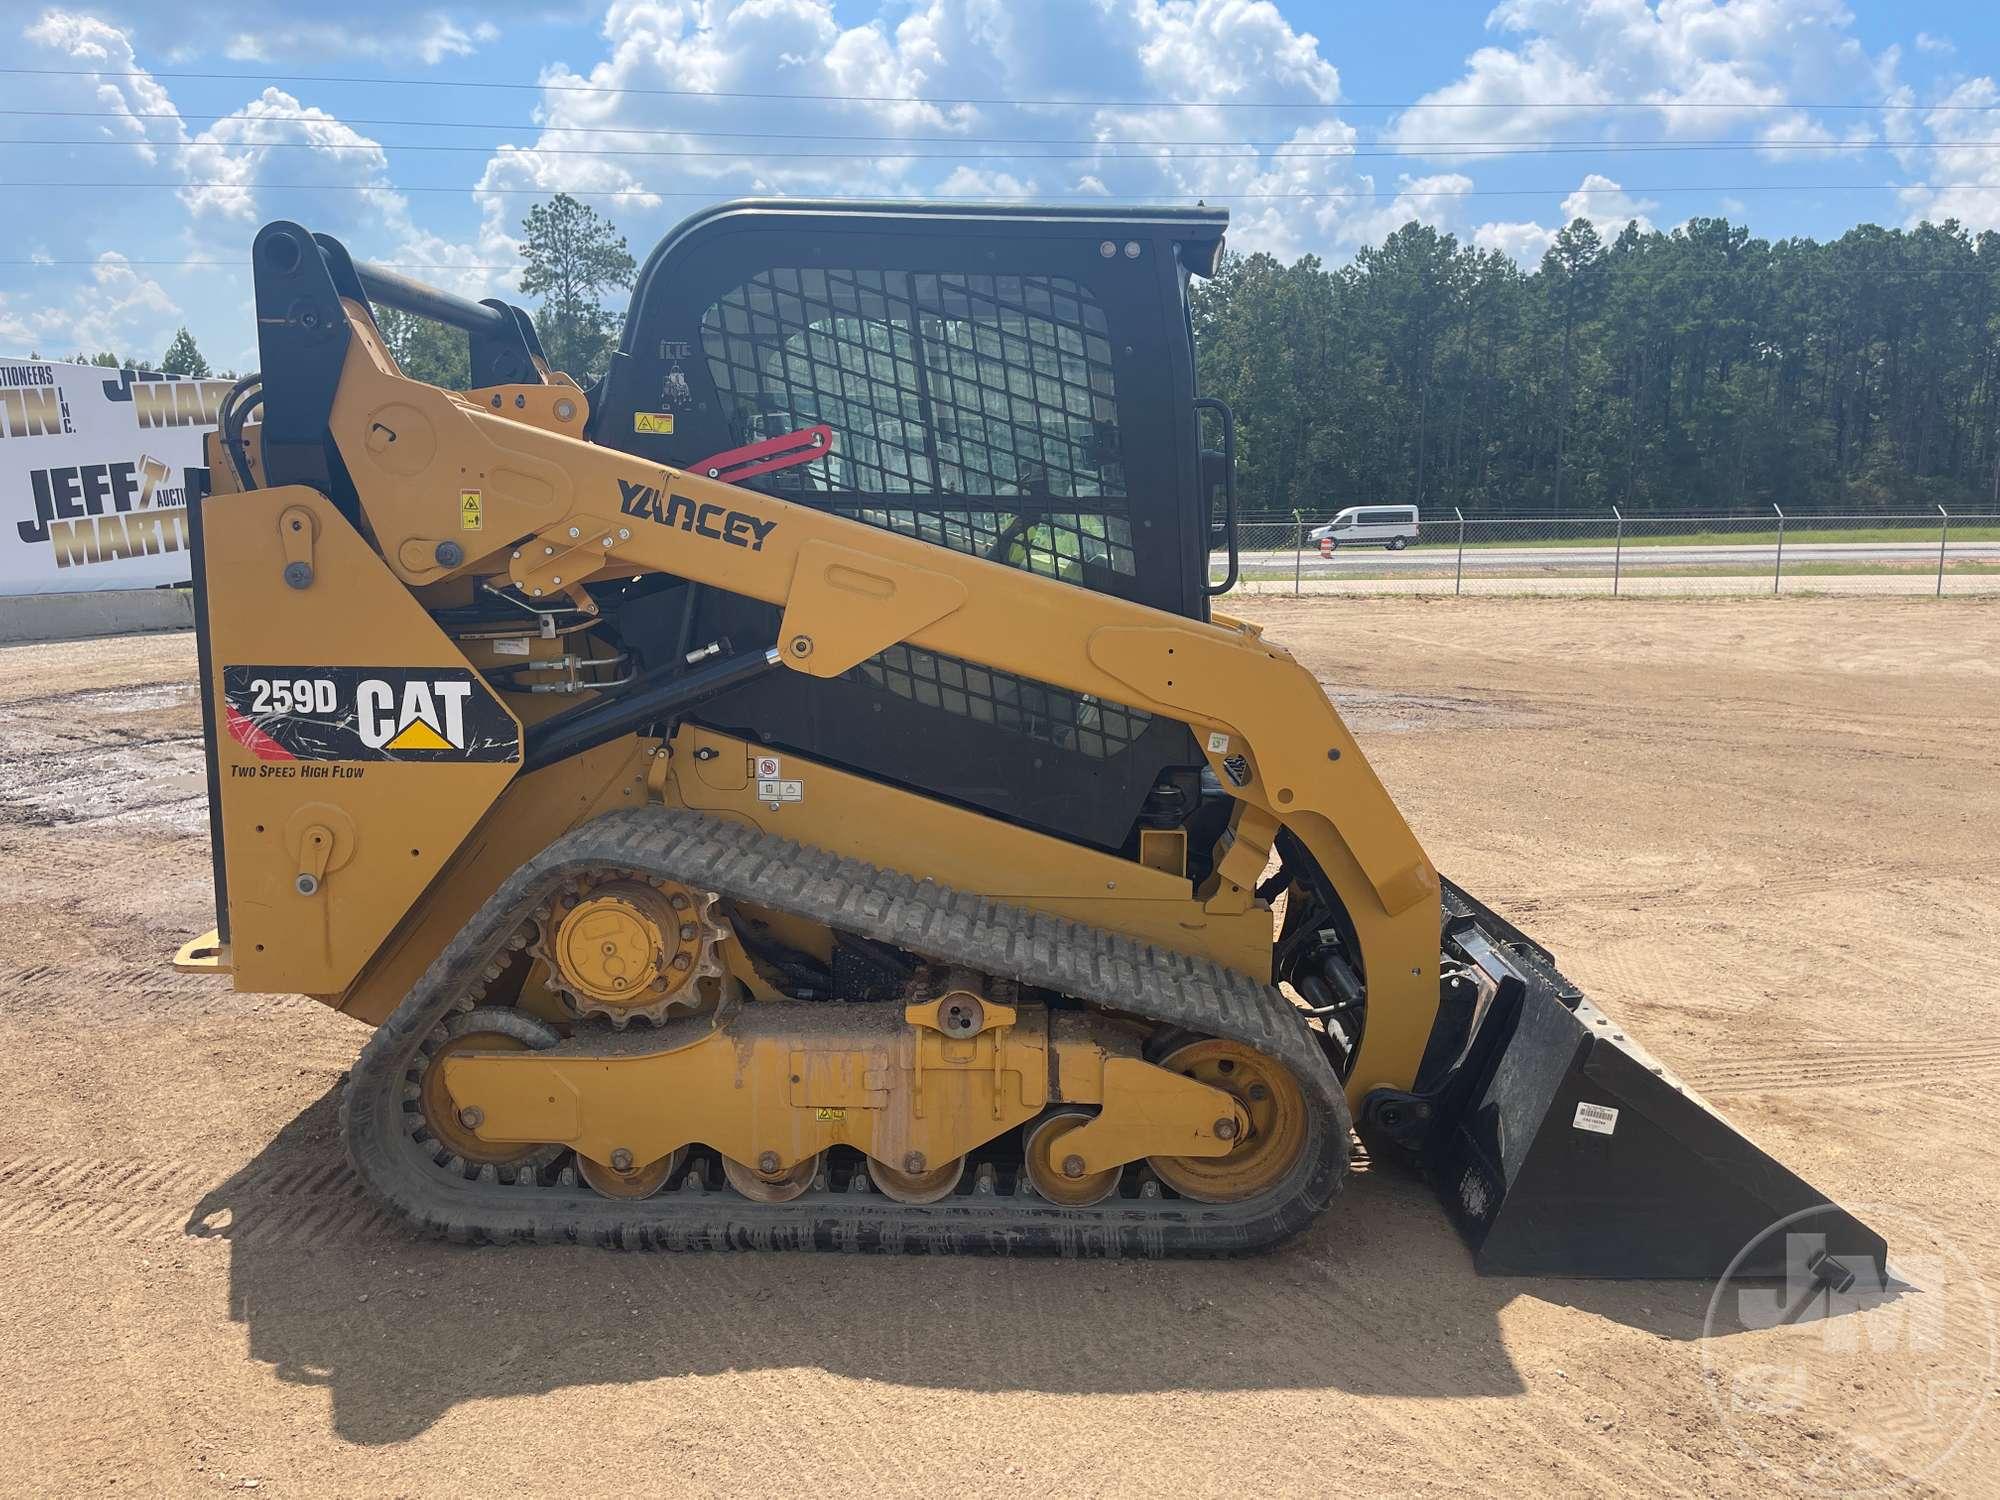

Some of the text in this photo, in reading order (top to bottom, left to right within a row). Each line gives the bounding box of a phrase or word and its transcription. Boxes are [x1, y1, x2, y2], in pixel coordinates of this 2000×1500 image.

[0, 366, 53, 386] TIONEERS
[133, 382, 262, 428] MAR
[17, 461, 138, 543] JEFF
[617, 479, 777, 552] YANCEY
[250, 679, 337, 713] 259D
[356, 679, 471, 749] CAT
